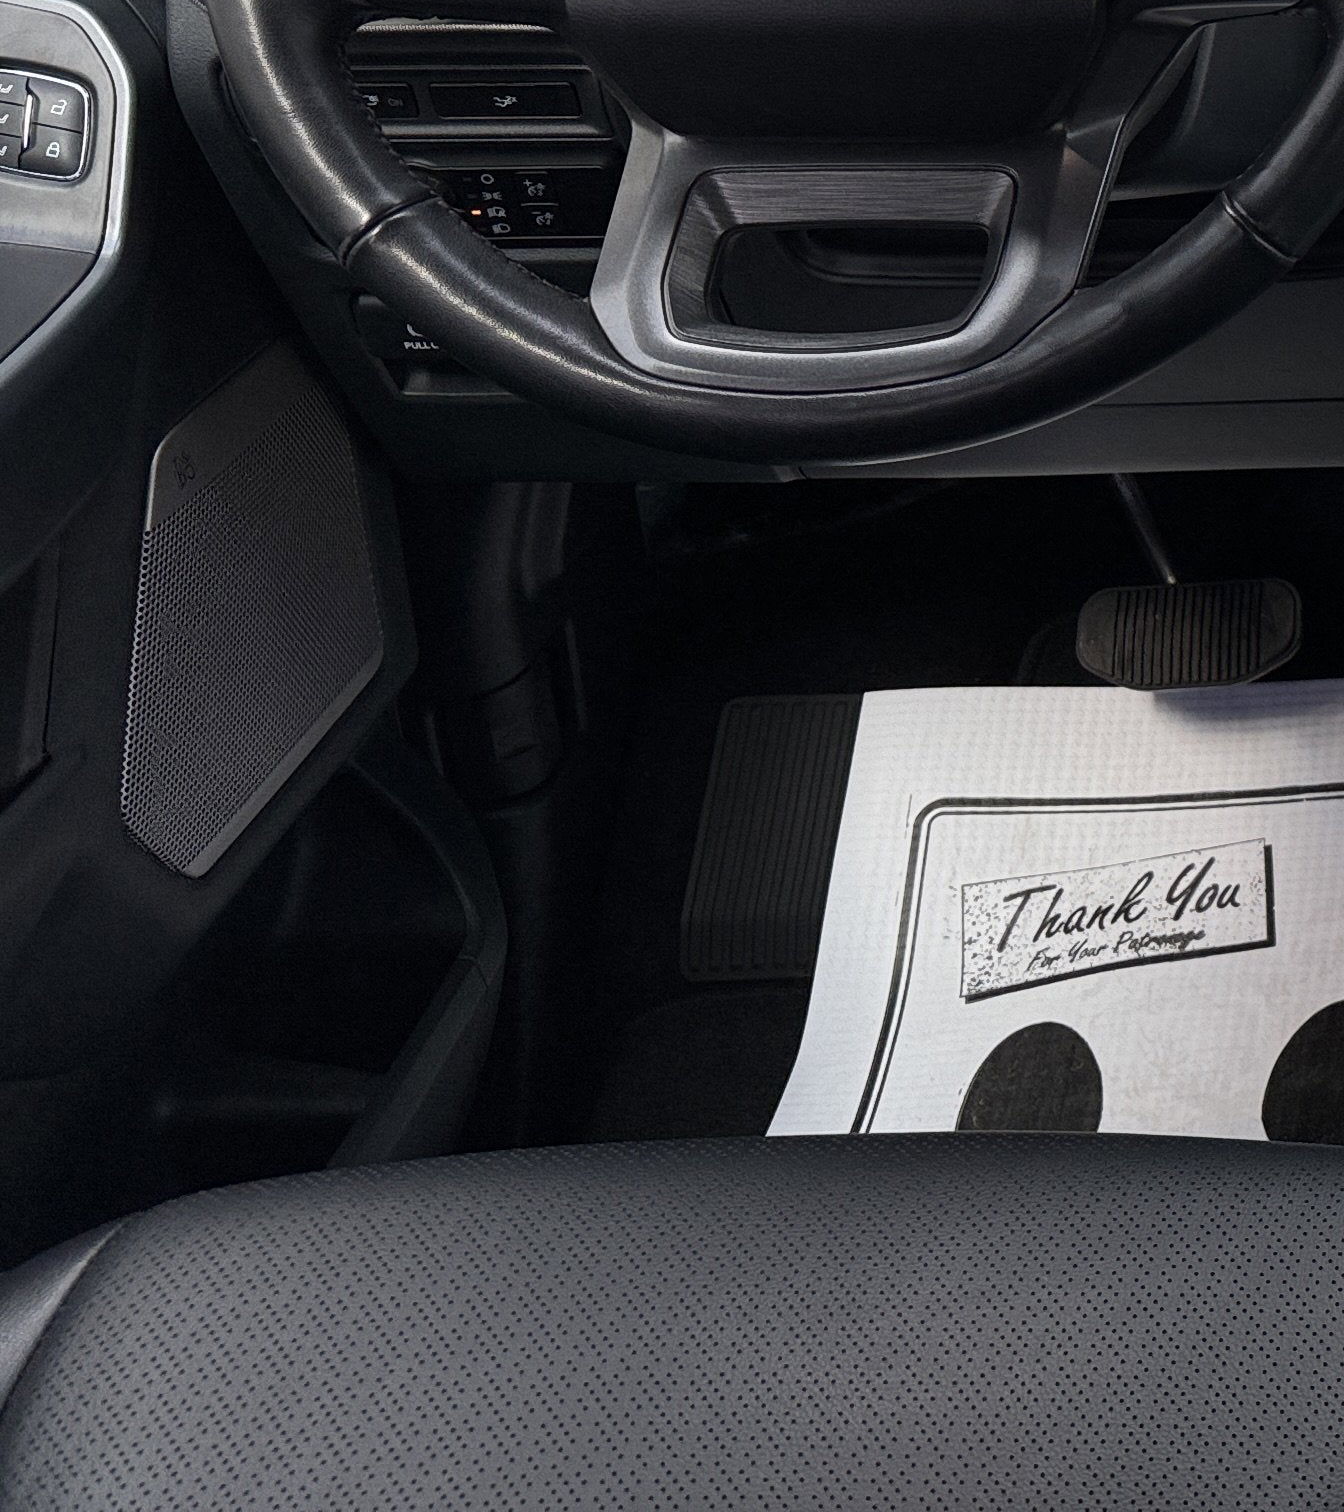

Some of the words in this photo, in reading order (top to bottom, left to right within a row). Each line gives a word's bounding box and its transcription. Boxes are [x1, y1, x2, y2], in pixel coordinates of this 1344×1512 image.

[403, 341, 439, 350] PULL
[997, 871, 1154, 952] Thank
[1166, 856, 1241, 921] You
[1026, 947, 1061, 971] For
[1068, 939, 1108, 963] Your
